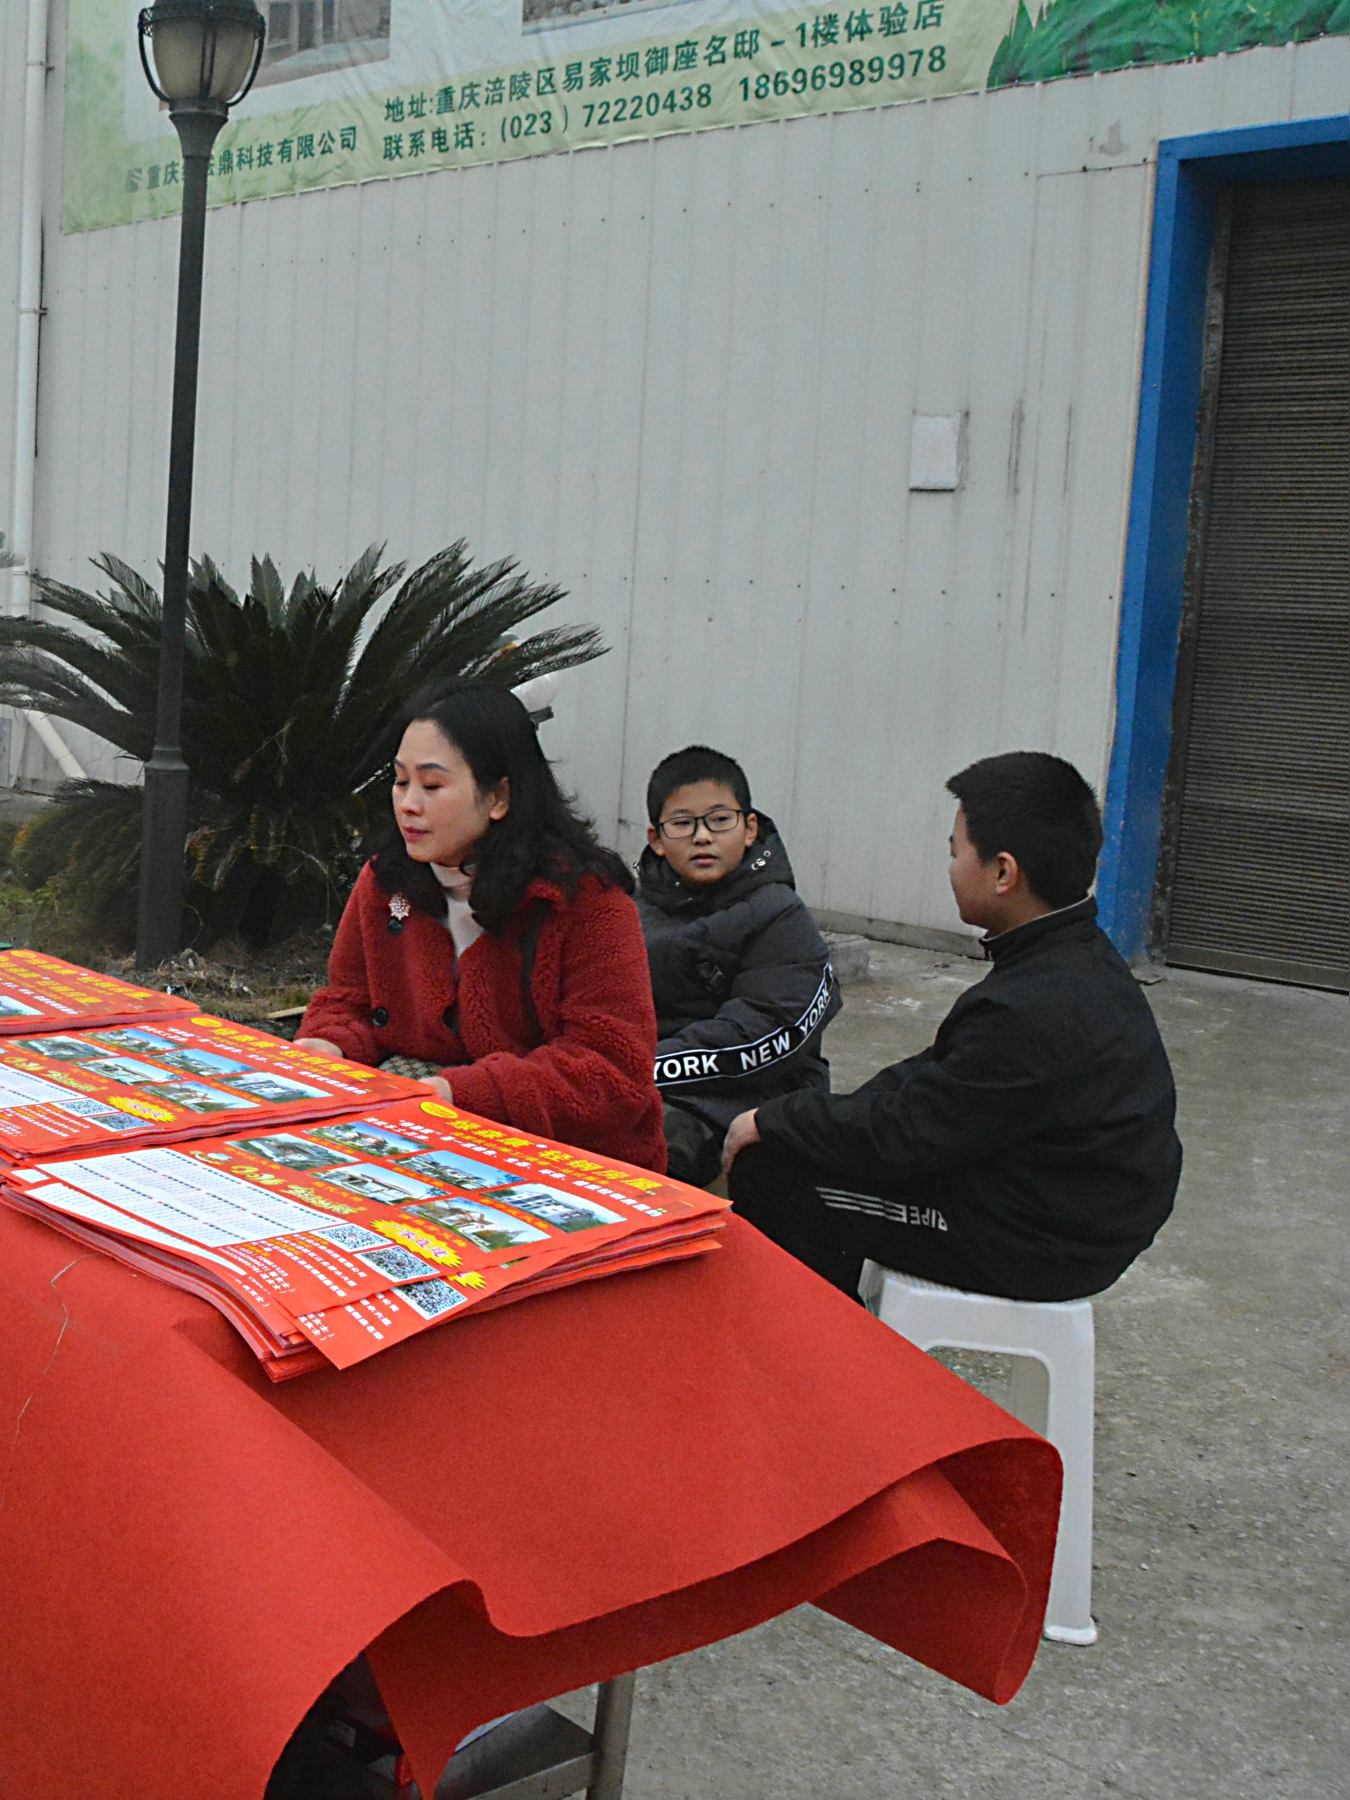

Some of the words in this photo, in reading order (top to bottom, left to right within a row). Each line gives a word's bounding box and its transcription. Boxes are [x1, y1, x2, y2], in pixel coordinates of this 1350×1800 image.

[738, 45, 947, 102] 18696989978
[146, 126, 358, 190] 重庆鼎科技有限公司
[653, 1054, 720, 1081] YORK
[740, 1031, 790, 1070] NEW
